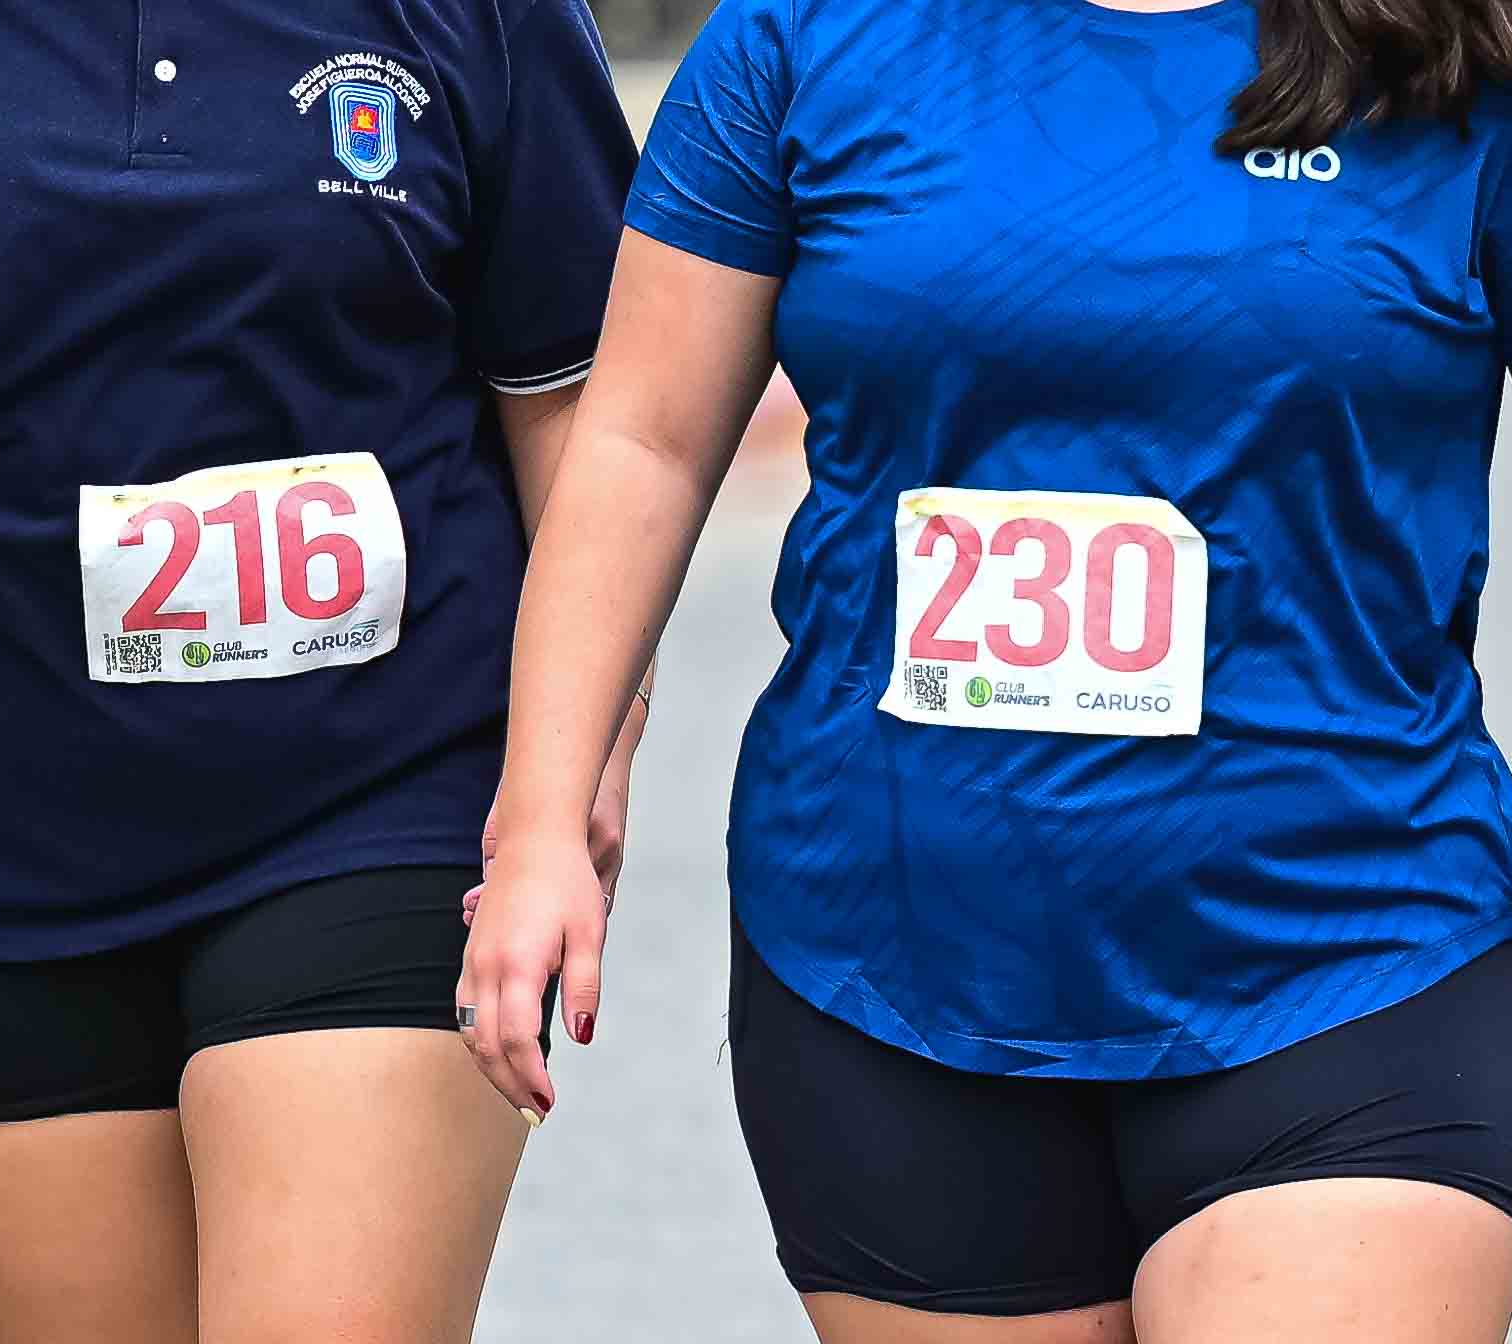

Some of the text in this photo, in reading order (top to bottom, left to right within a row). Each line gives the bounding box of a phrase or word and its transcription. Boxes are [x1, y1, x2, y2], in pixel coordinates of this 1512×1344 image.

[335, 52, 386, 68] NORMAL
[385, 59, 431, 105] SUPERIOR
[295, 83, 322, 115] JOSE
[382, 73, 423, 122] ALCORTA
[317, 179, 408, 203] BELL VILLE
[117, 481, 365, 633] 216
[908, 513, 1176, 673] 230
[213, 640, 242, 654] CLUB
[292, 628, 376, 656] CARUSO
[211, 648, 268, 665] RUNNER'S
[995, 681, 1025, 694] CLUB
[993, 693, 1050, 707] RUNNER'S
[1076, 691, 1171, 714] CARUSO
